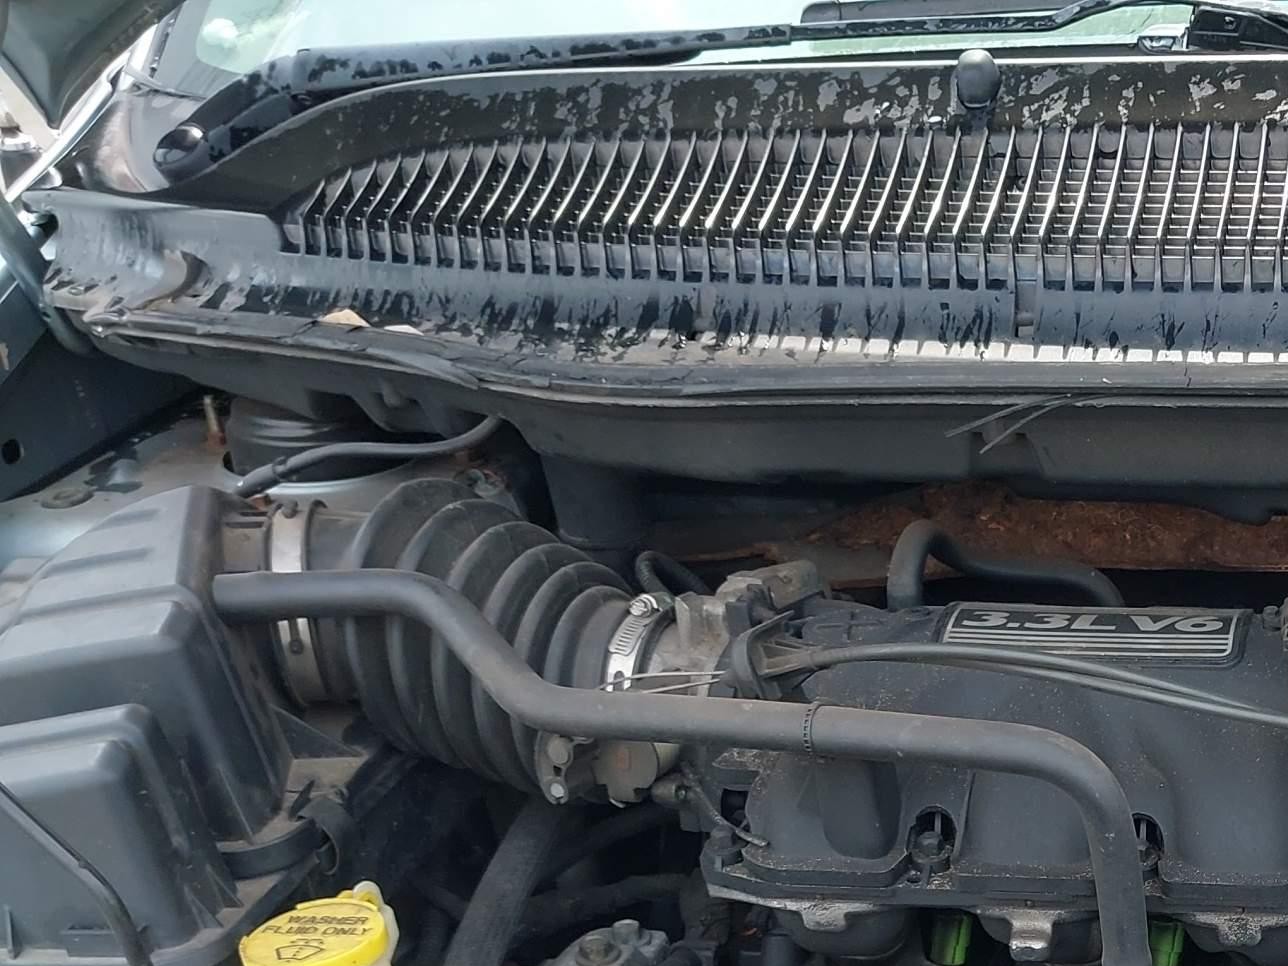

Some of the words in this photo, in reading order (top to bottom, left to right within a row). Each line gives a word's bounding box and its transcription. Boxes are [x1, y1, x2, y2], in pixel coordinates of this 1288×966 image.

[962, 611, 1116, 630] 3.3L
[1129, 615, 1225, 632] V6
[287, 915, 369, 925] WASHER
[261, 925, 319, 935] FLUID
[322, 926, 374, 936] ONLY
